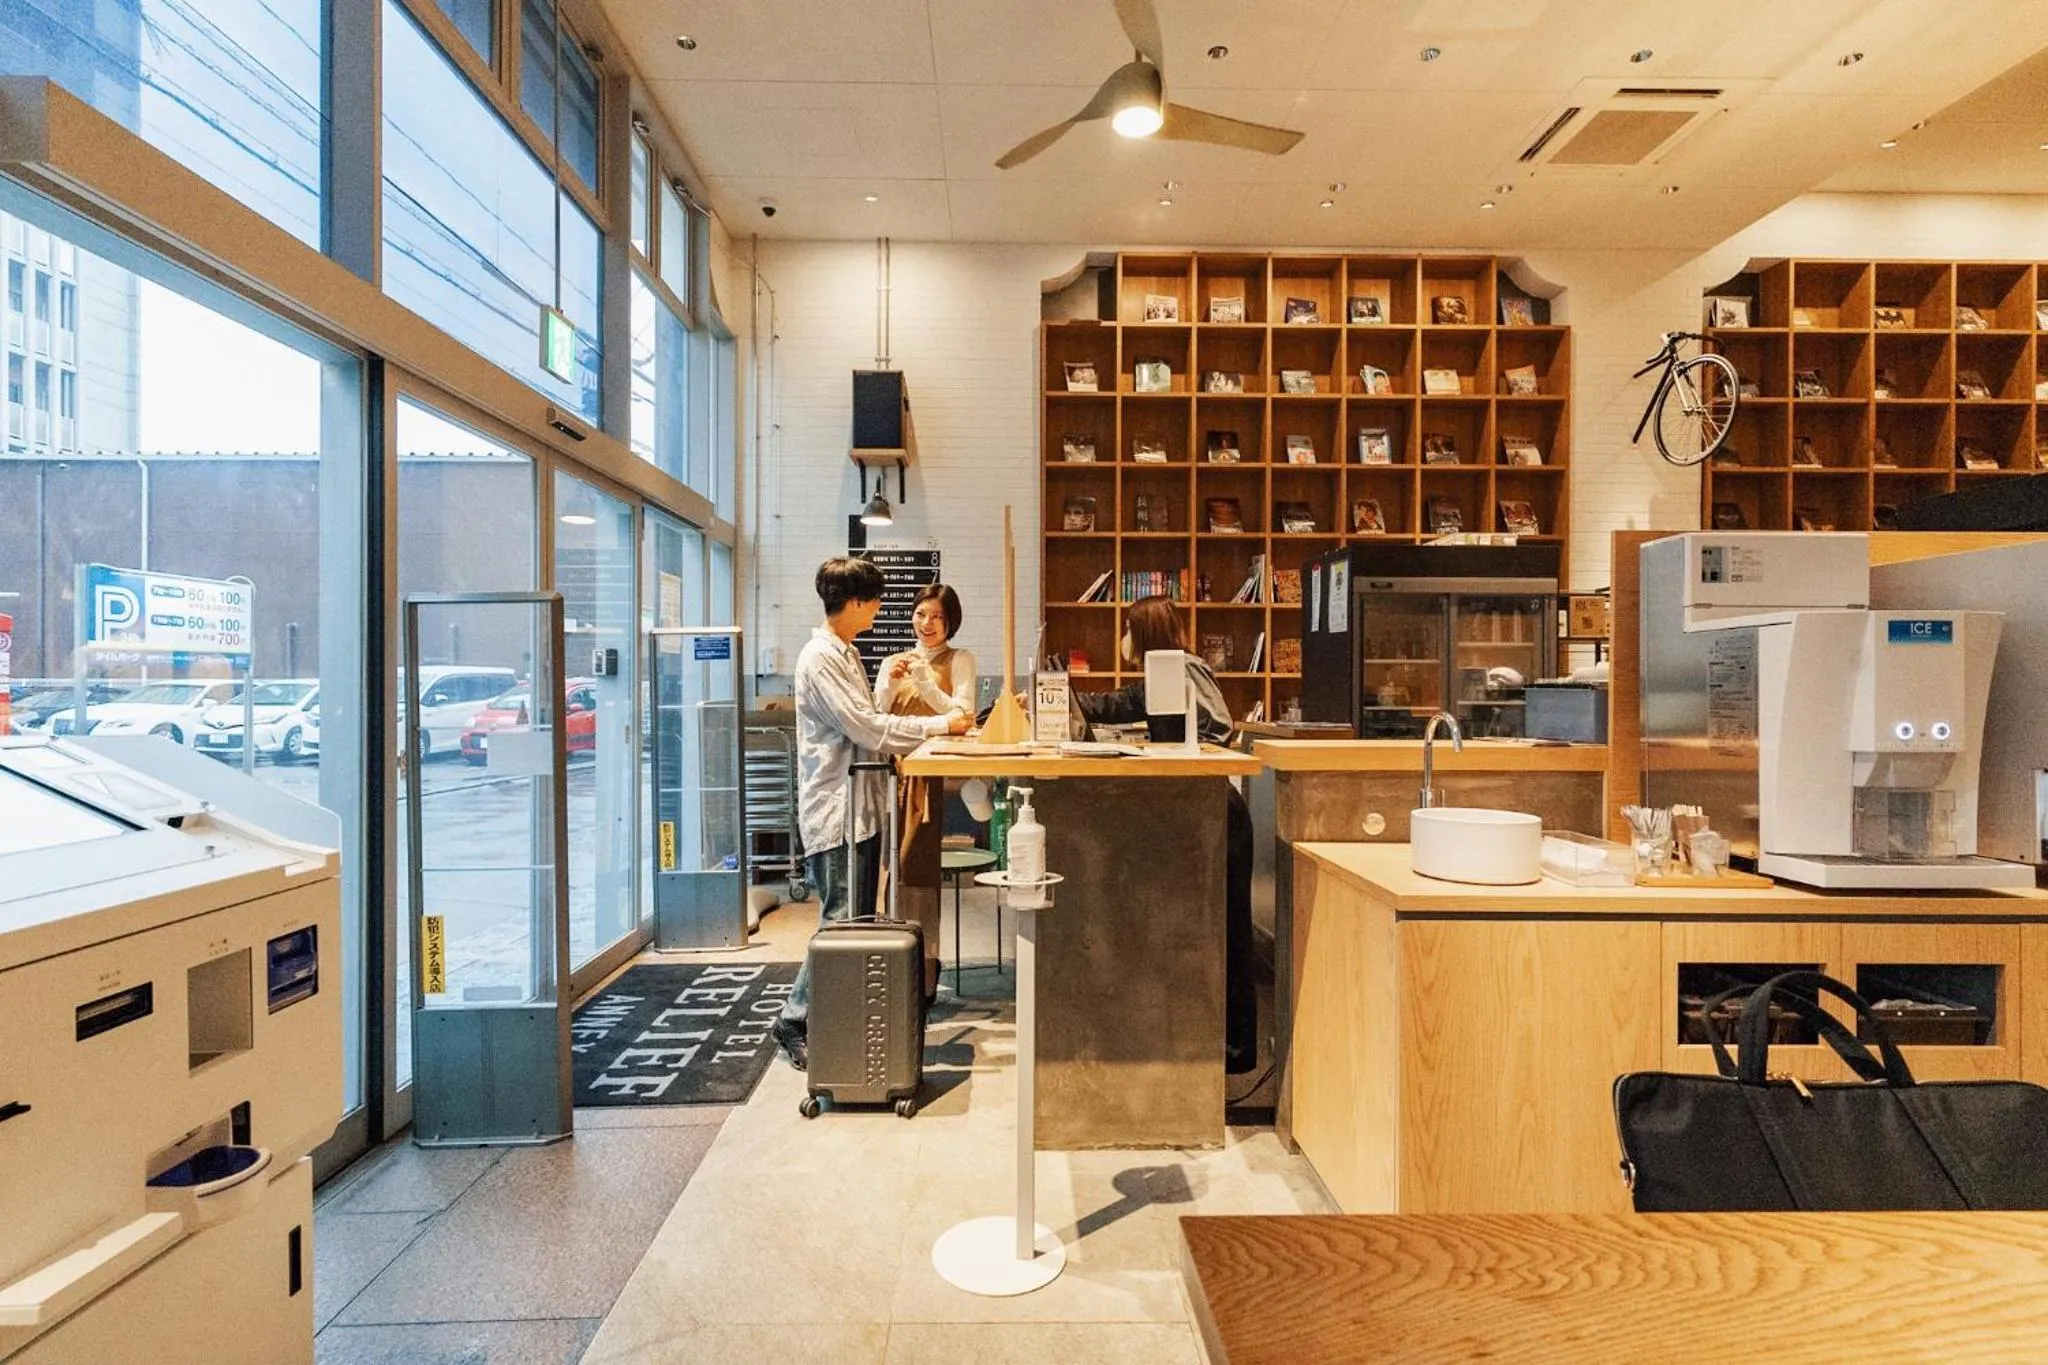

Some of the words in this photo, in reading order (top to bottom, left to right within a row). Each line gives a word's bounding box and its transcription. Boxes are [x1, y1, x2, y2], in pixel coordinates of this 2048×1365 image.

[931, 552, 939, 566] 8
[931, 569, 939, 585] 7
[1910, 622, 1932, 634] ICE
[589, 964, 766, 1098] RELIEF
[710, 983, 795, 1063] HOTEL
